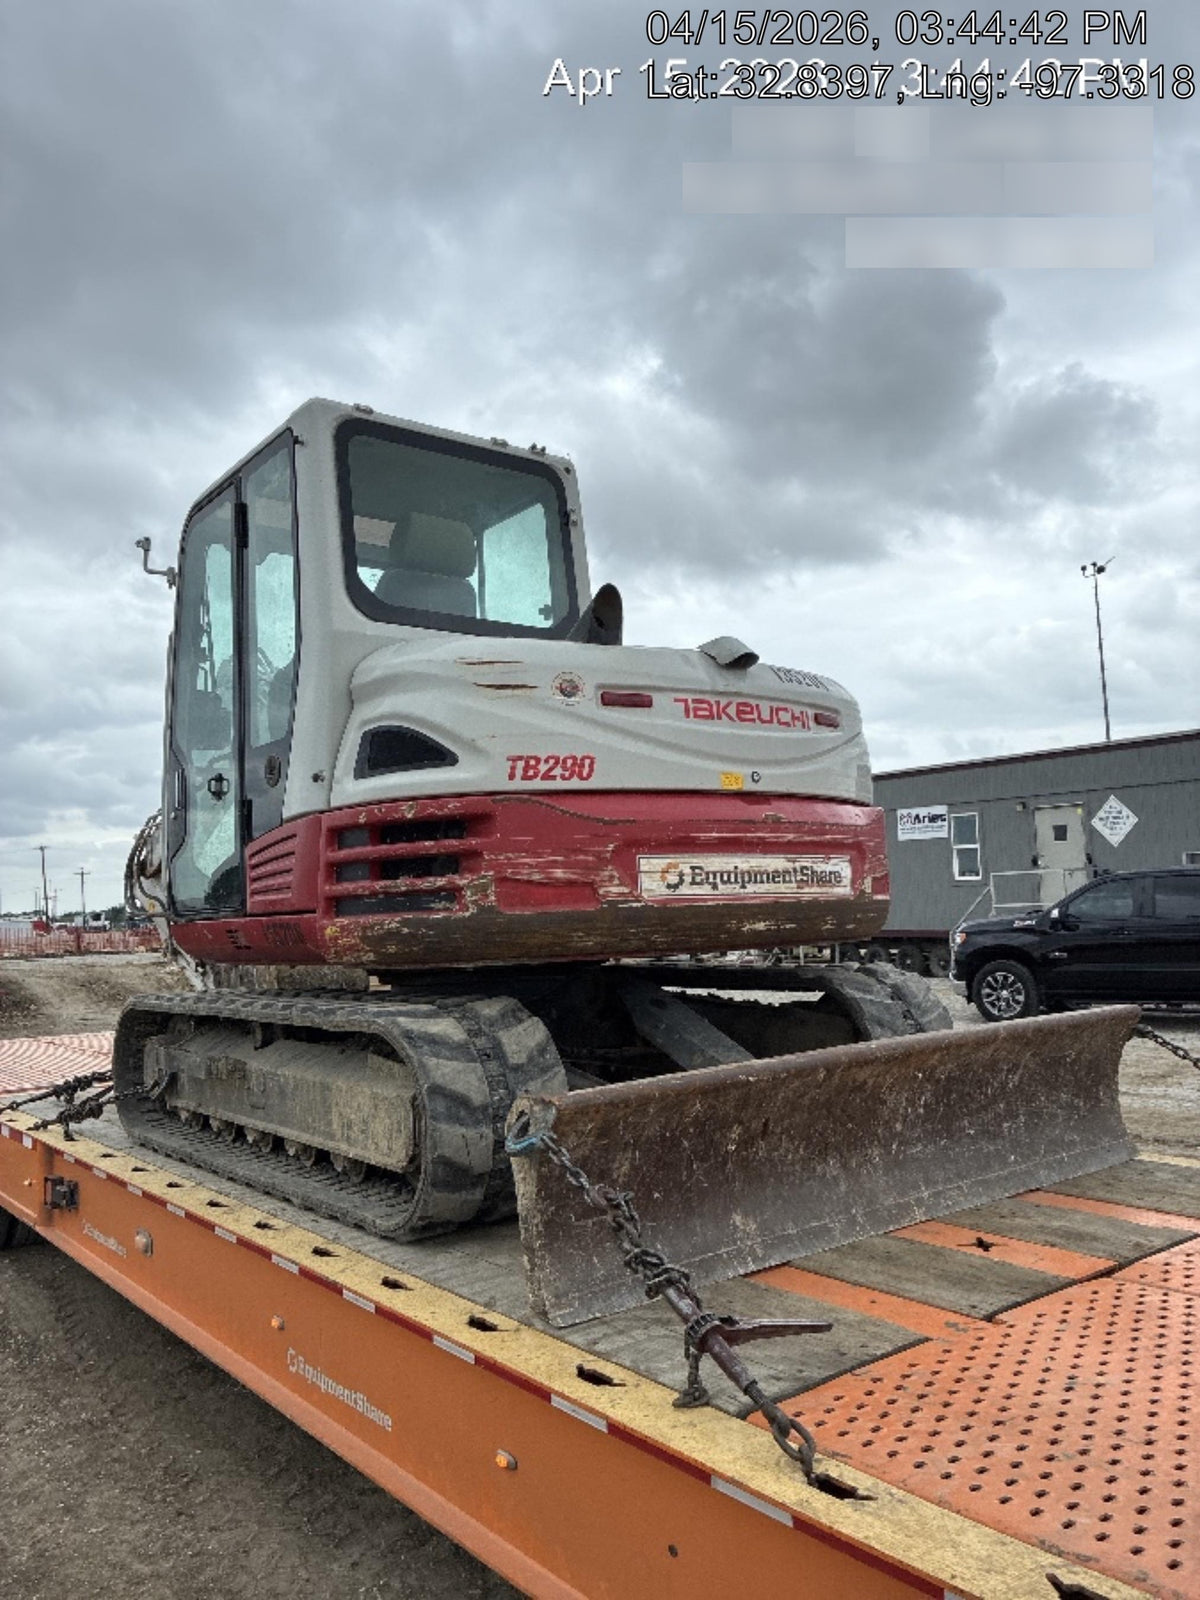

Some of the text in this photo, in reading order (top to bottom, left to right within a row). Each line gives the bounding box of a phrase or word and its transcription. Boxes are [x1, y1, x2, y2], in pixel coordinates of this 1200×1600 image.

[506, 755, 597, 781] TB290
[689, 865, 843, 890] EquipmentShare
[298, 1355, 392, 1432] EquipmentShare
